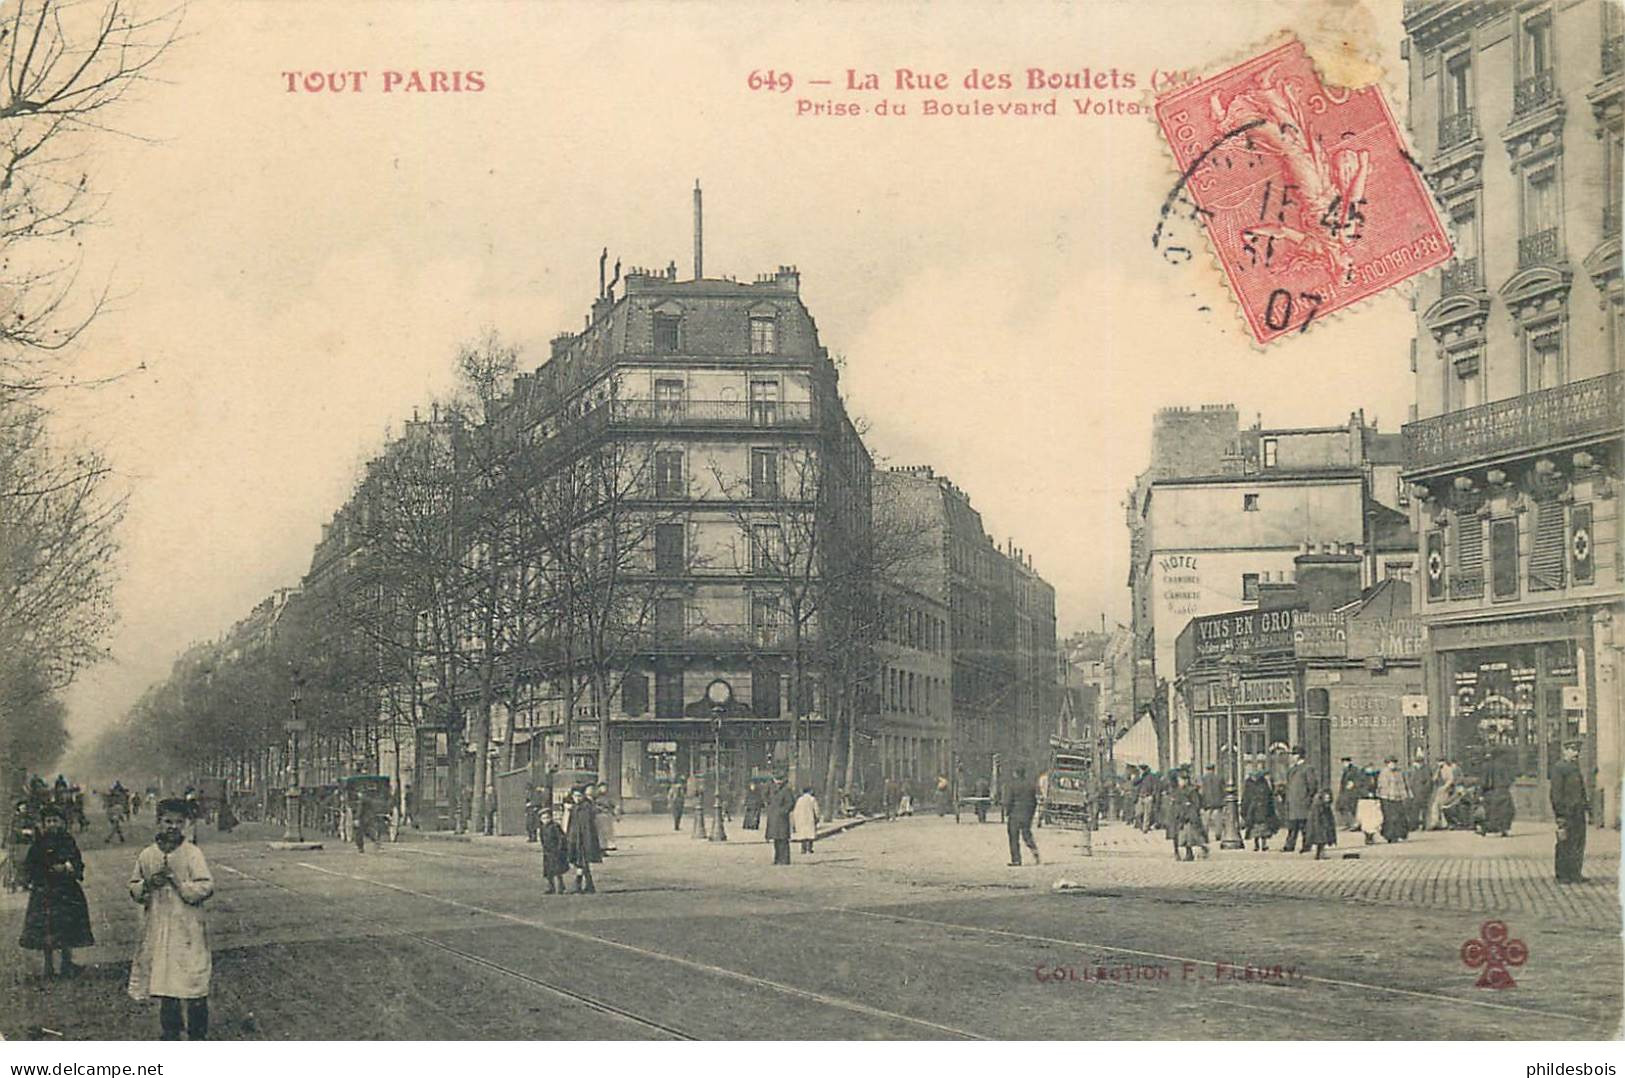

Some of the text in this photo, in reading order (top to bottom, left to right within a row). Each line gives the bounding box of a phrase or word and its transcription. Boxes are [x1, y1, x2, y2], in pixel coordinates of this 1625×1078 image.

[1265, 288, 1323, 333] 07
[1199, 609, 1294, 640] VINS EN GRO
[1244, 680, 1293, 703] LIQUEURS
